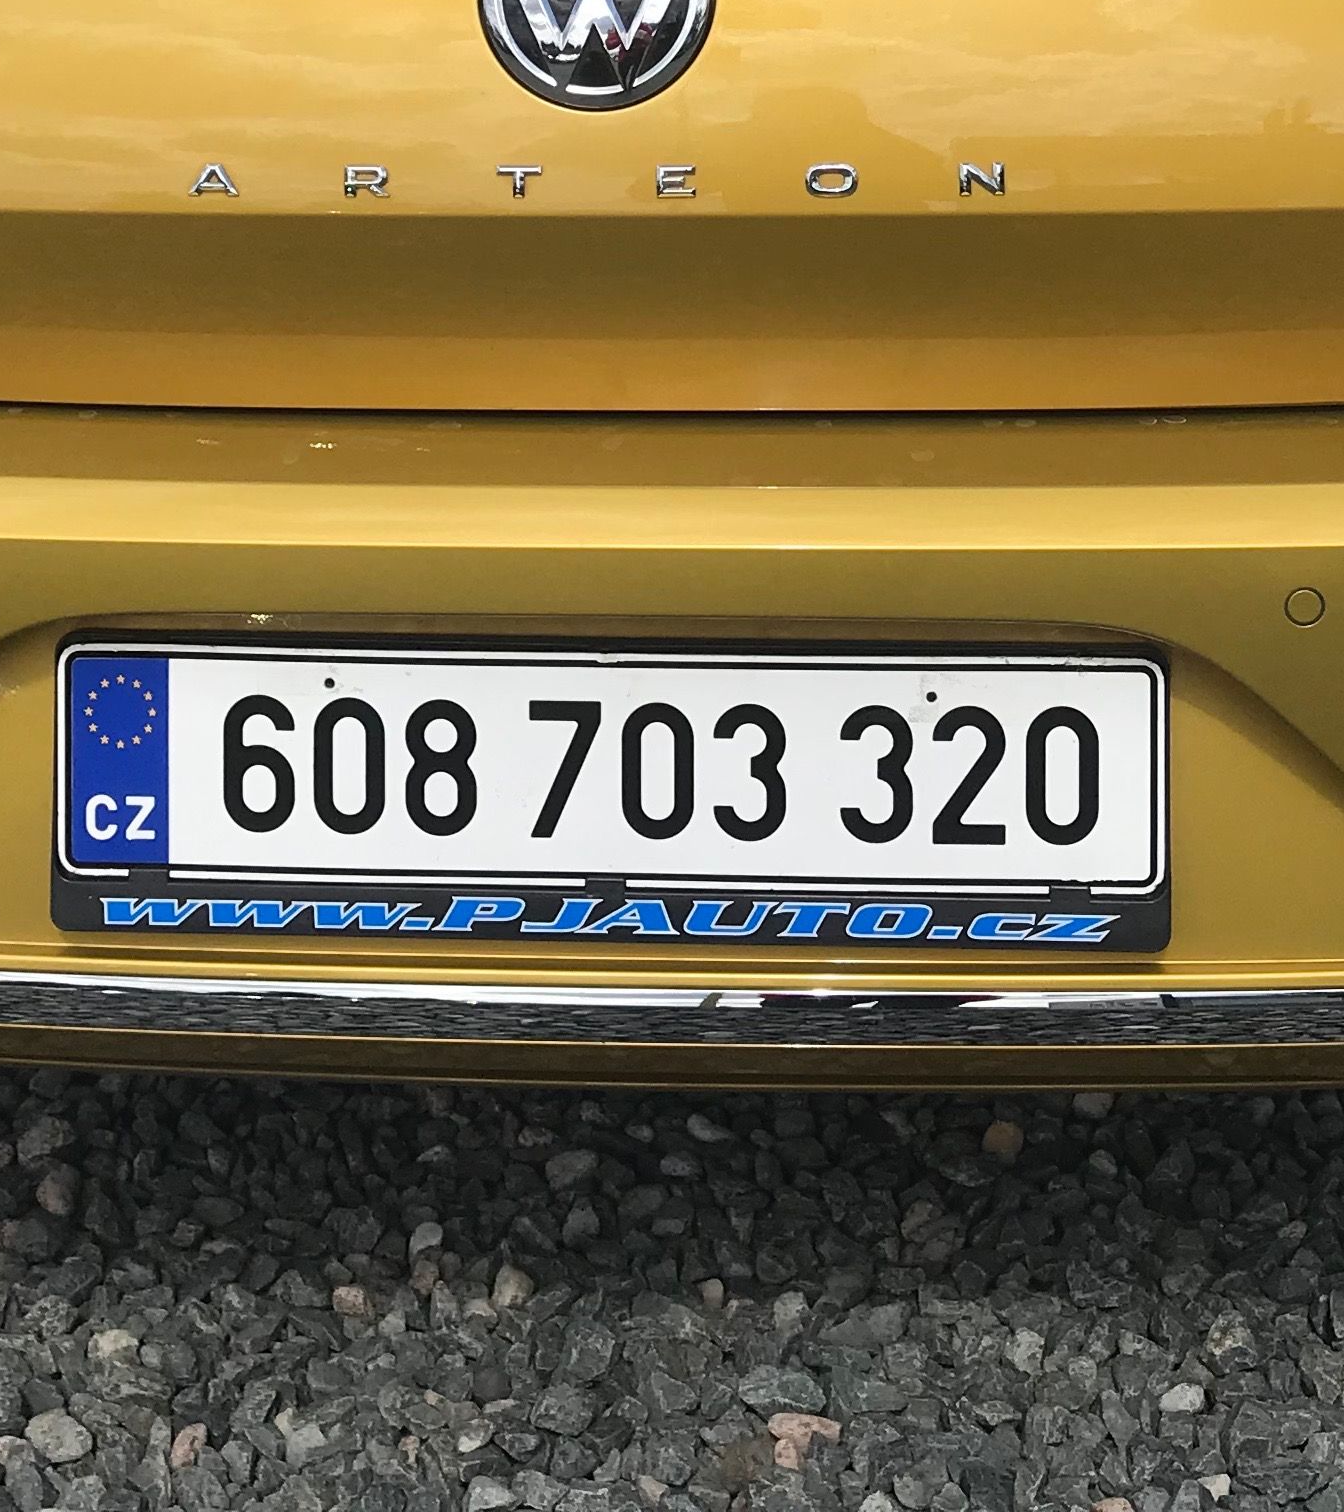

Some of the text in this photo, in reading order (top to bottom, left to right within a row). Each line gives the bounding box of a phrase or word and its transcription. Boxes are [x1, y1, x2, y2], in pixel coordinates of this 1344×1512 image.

[188, 161, 1008, 200] ARTEON
[221, 695, 1101, 846] 608 703 320
[85, 794, 156, 841] CZ
